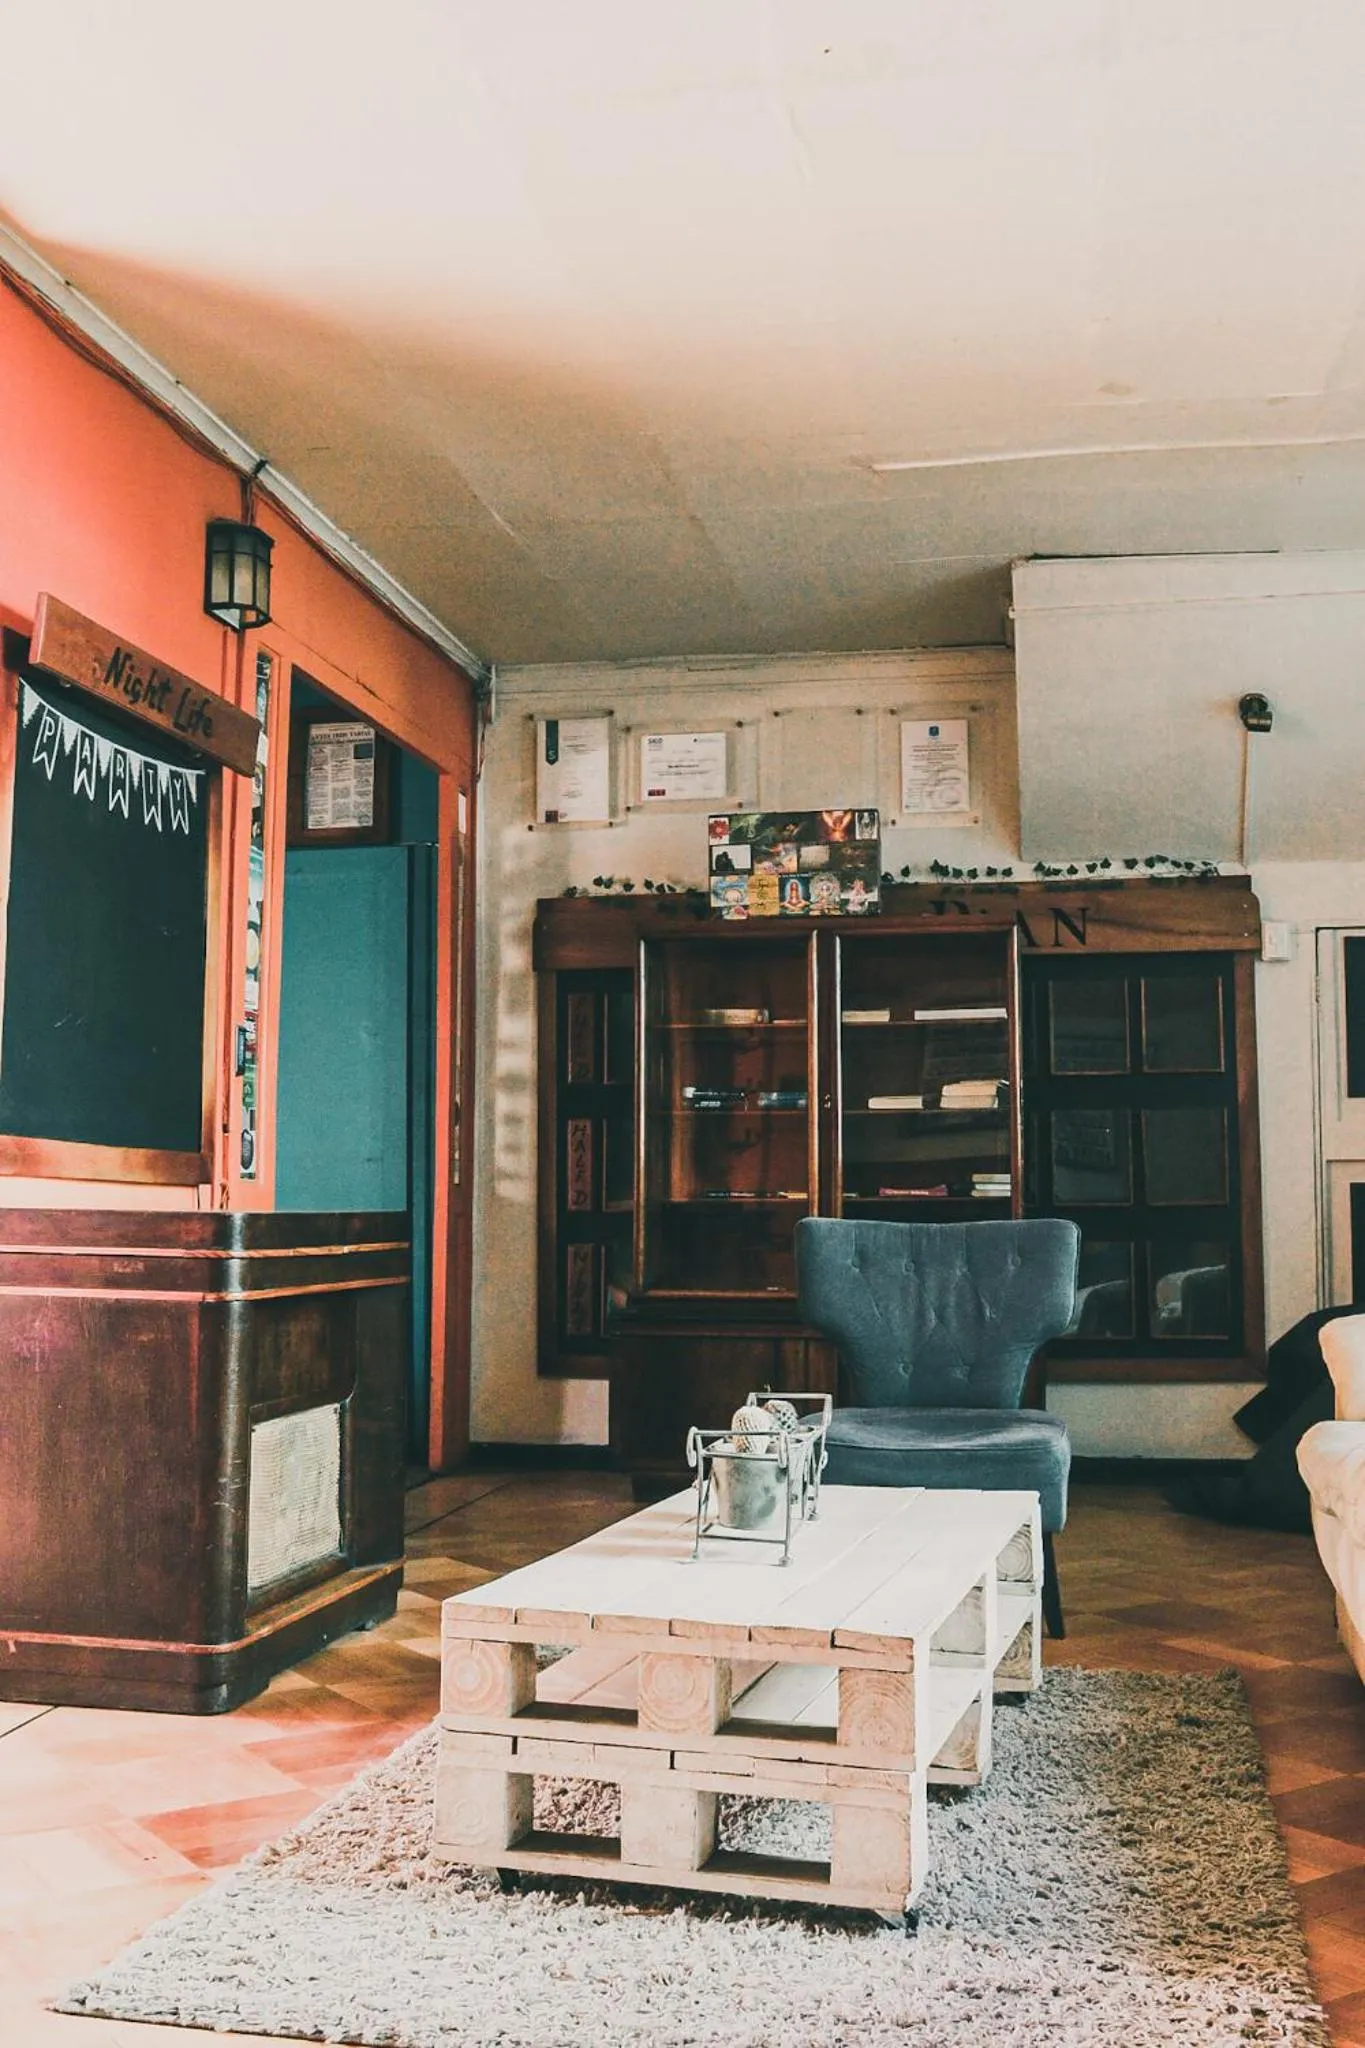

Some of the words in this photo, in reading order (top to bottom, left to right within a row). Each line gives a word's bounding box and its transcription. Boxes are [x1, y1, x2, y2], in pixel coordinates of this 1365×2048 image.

[104, 646, 173, 713] Night
[173, 687, 213, 737] Life
[42, 716, 182, 800] PARTY
